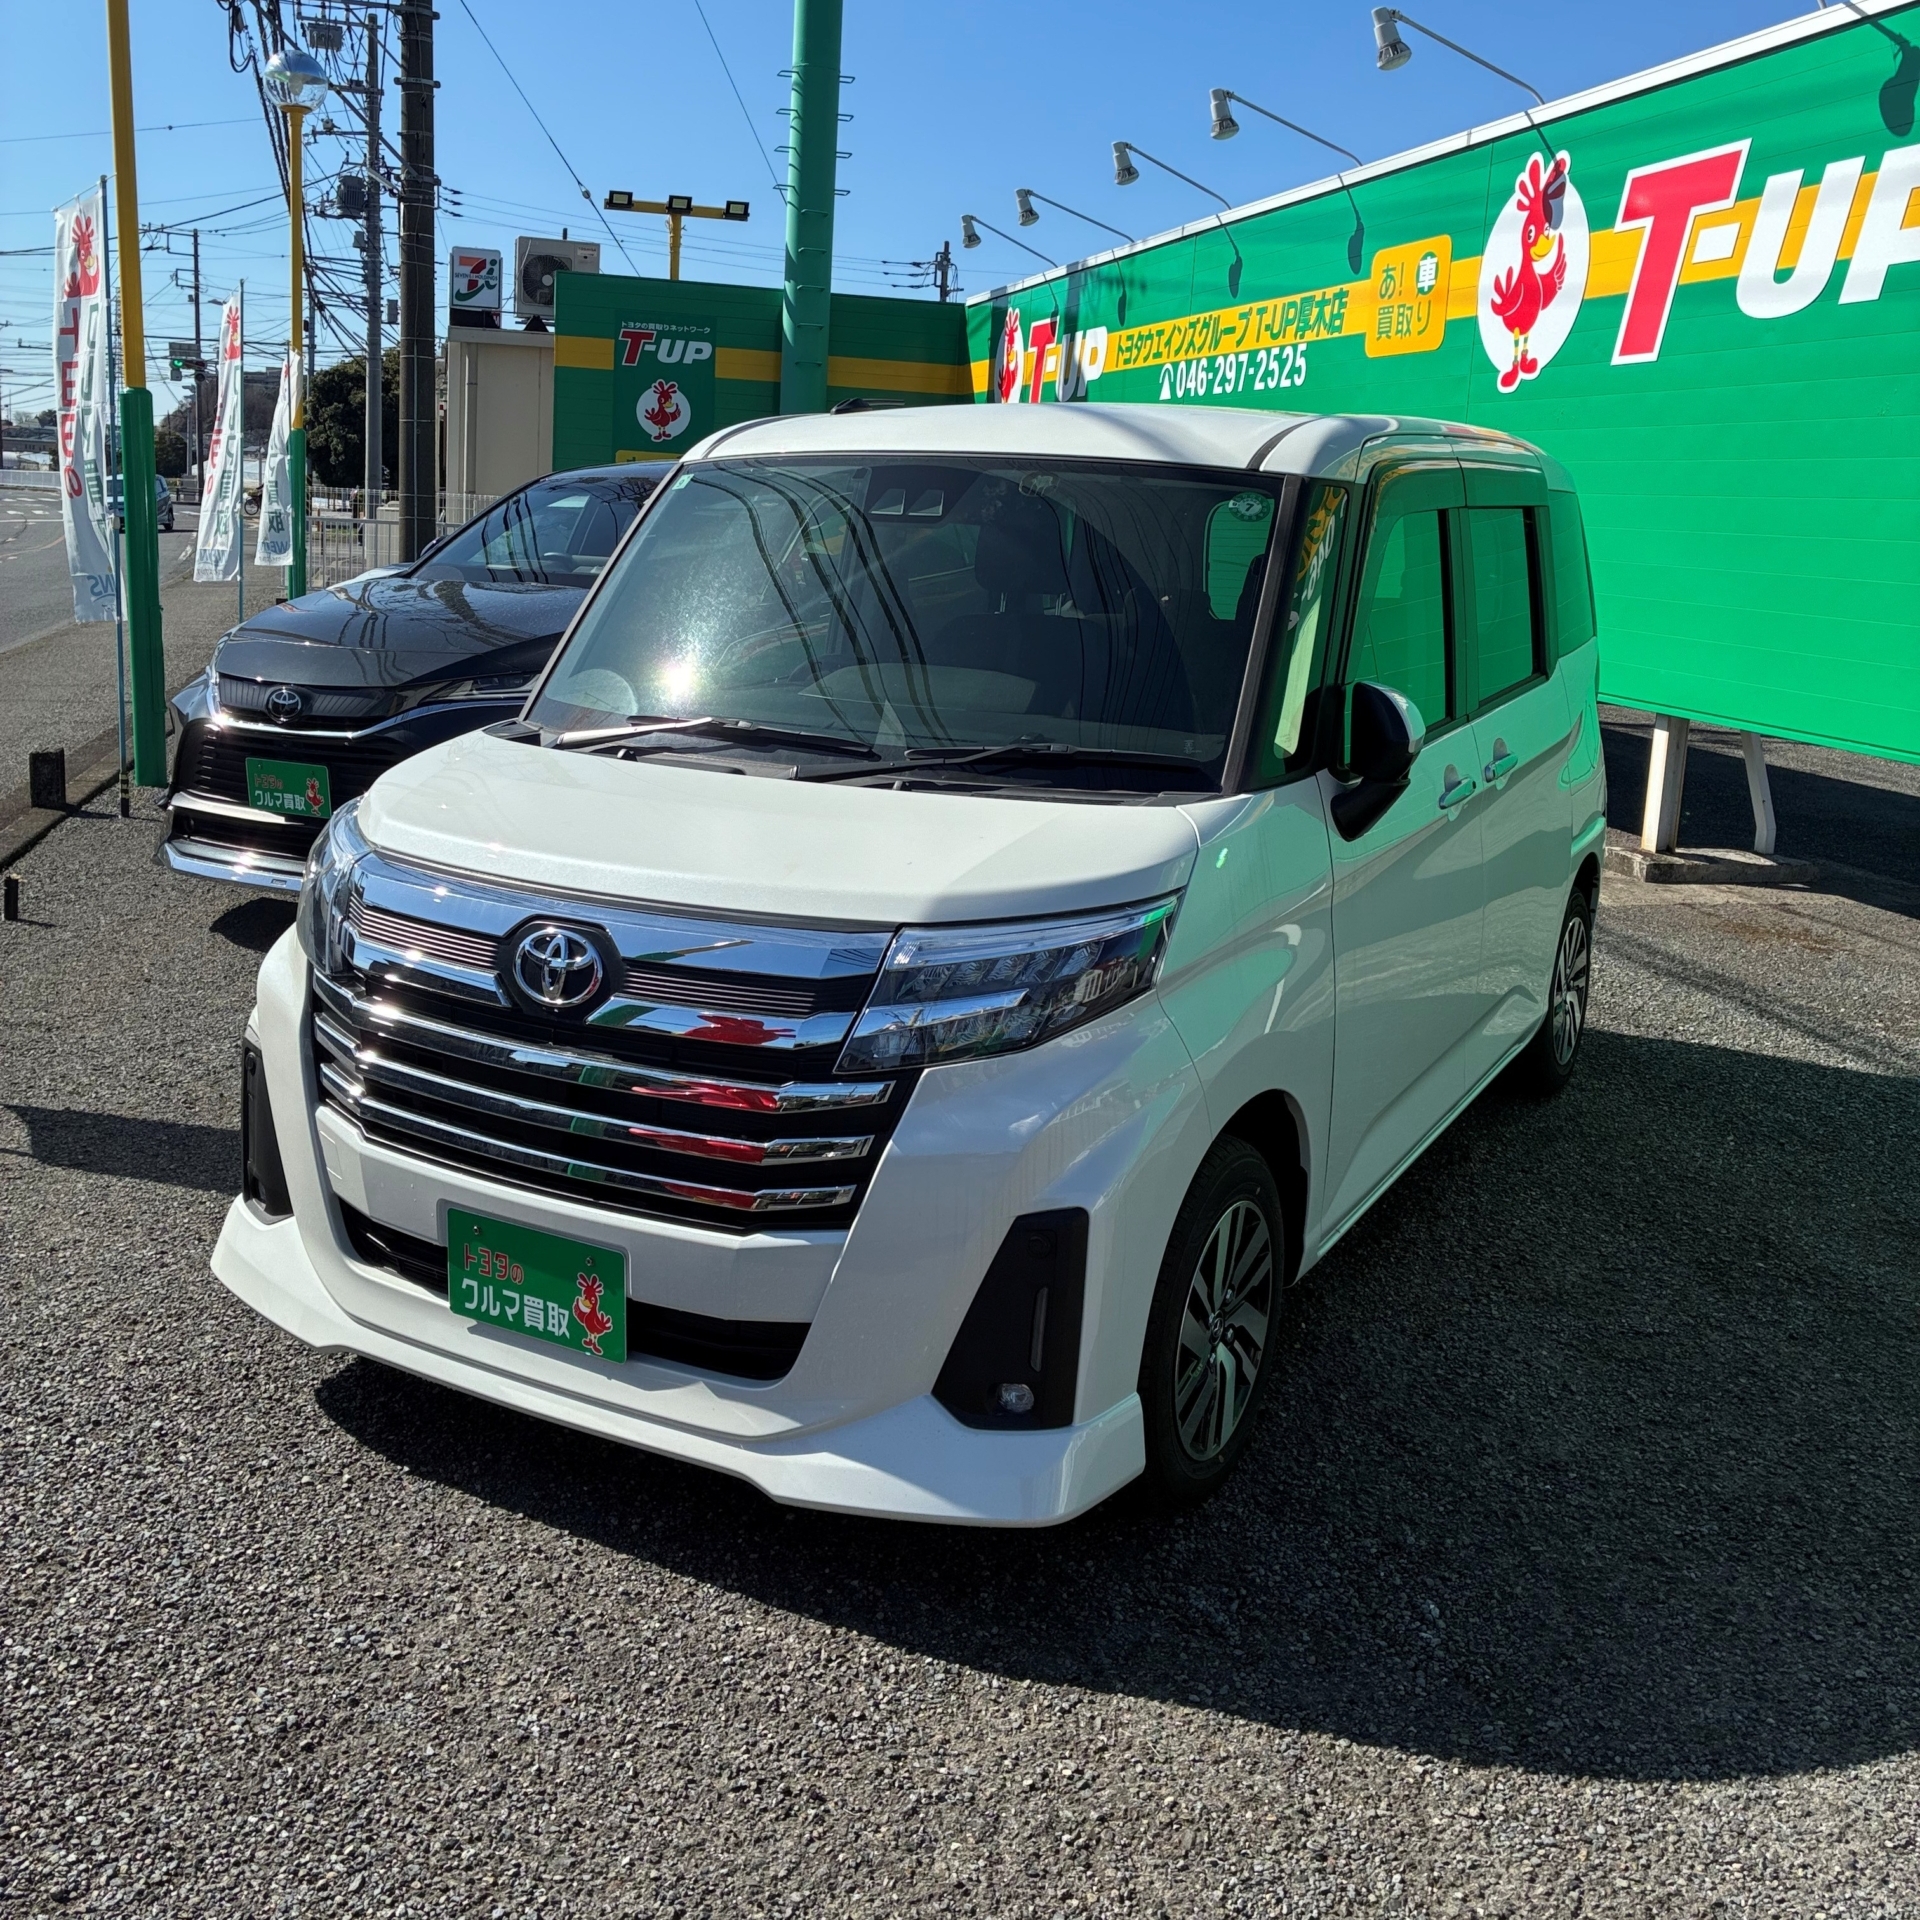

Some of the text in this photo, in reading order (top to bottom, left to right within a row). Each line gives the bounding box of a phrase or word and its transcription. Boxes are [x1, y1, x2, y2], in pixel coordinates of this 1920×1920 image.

[621, 321, 711, 334] トヨタの買取りネットワーク
[1376, 300, 1432, 341] 買取り
[618, 328, 713, 366] T-UP
[1029, 314, 1109, 403] T-UP
[1176, 343, 1307, 398] 046-297-2525
[254, 773, 283, 789] トヨタの
[255, 790, 306, 811] クルマ買取
[463, 1243, 524, 1285] トヨタの
[461, 1277, 570, 1339] クルマ買取
